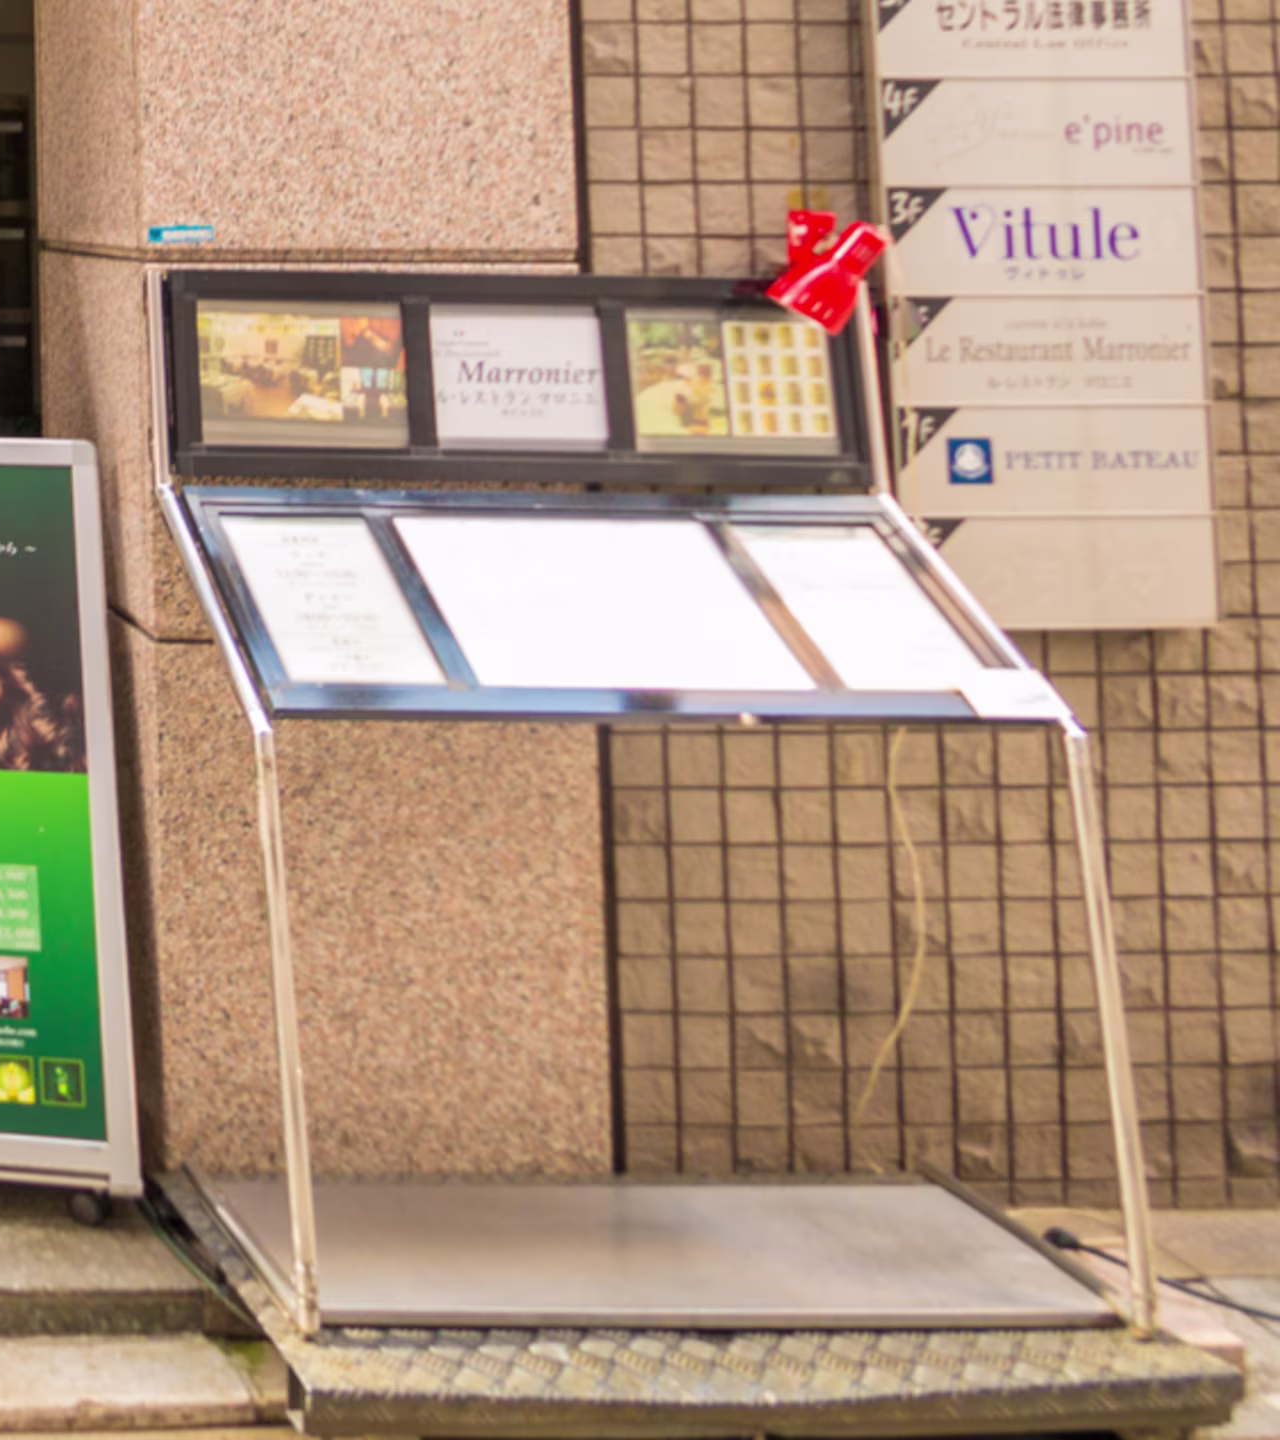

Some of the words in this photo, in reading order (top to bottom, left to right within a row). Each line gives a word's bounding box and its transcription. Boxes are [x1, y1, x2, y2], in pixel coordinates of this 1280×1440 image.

[883, 84, 918, 117] 4F
[891, 192, 923, 224] 3F
[948, 203, 1140, 261] Vitule
[925, 336, 950, 363] Le
[959, 336, 1073, 363] Restaurant
[457, 360, 600, 385] Marronier
[1005, 451, 1080, 470] PETIT
[1091, 451, 1200, 470] BATEAU
